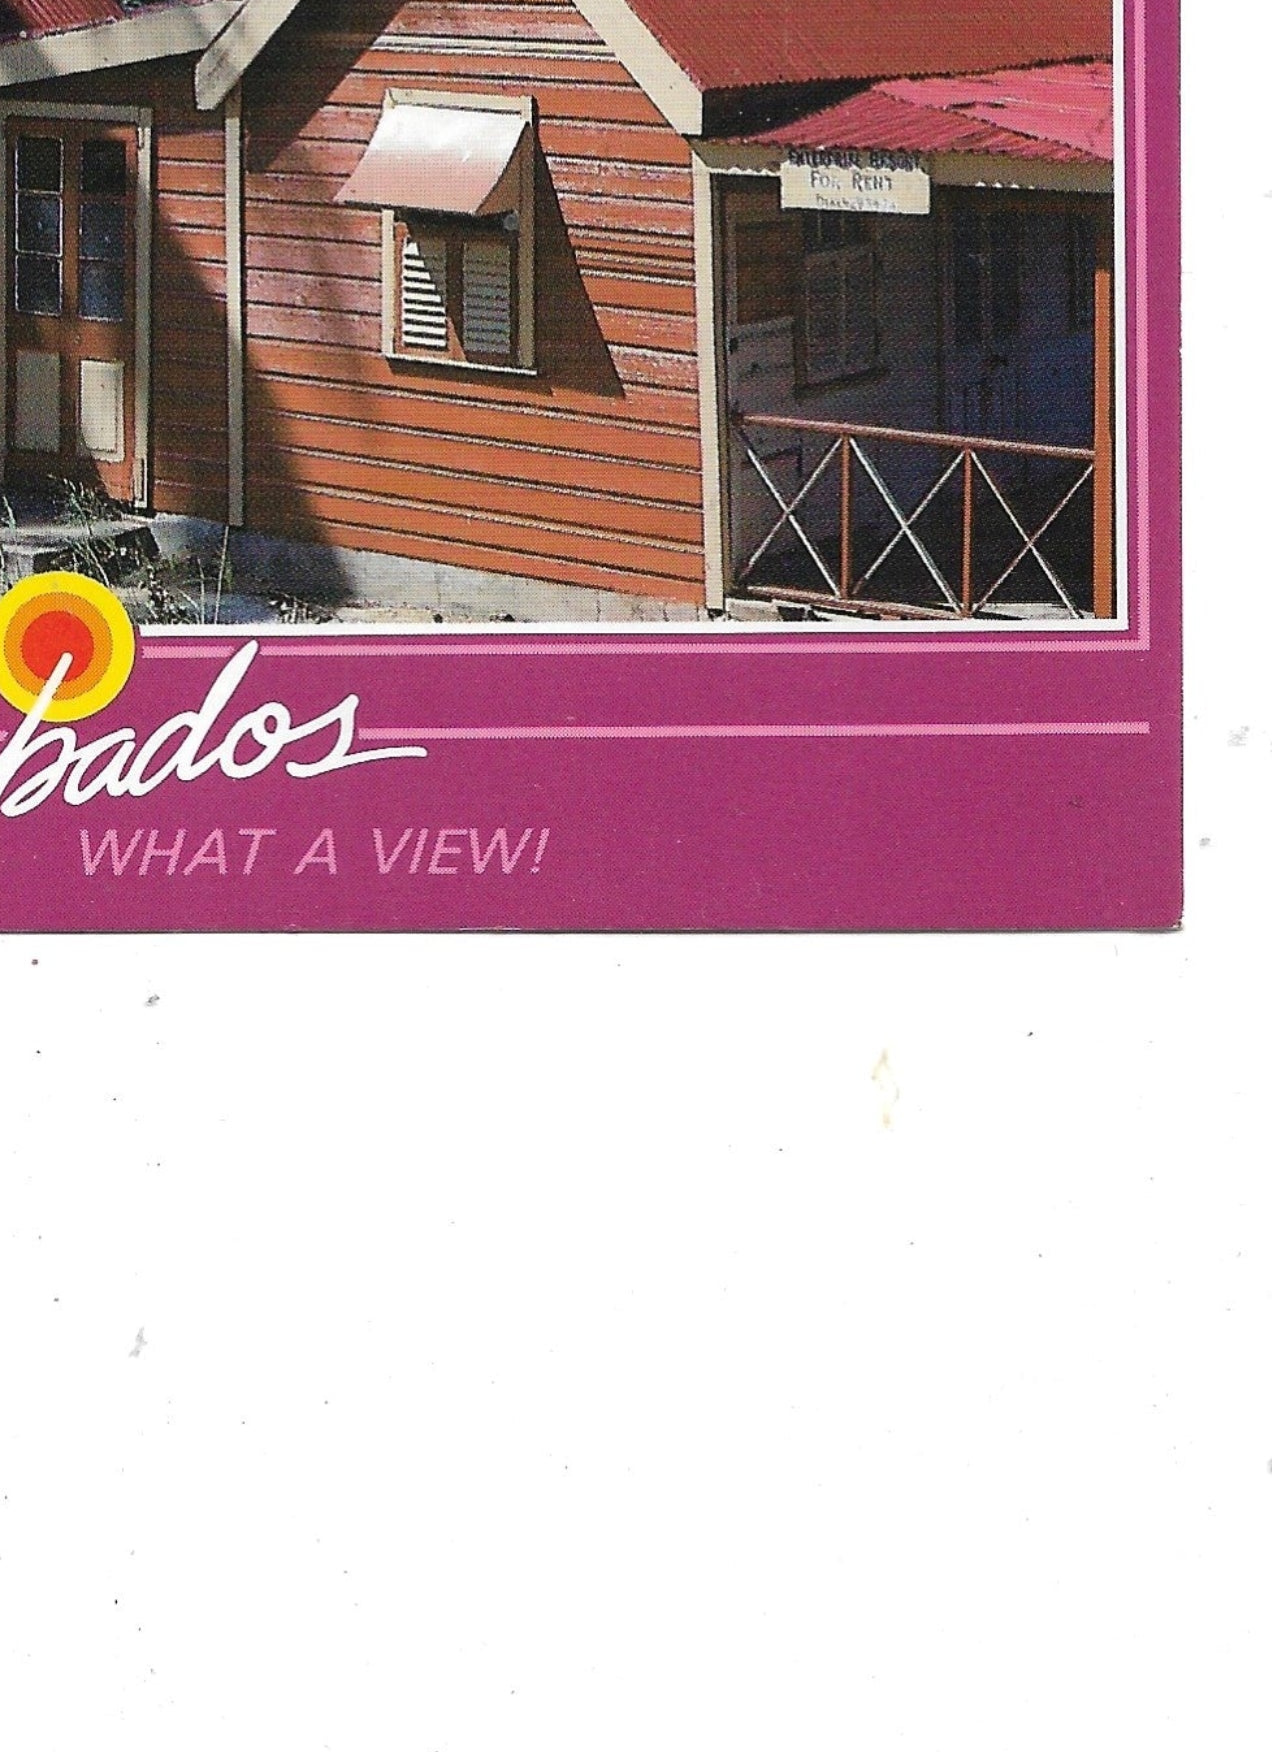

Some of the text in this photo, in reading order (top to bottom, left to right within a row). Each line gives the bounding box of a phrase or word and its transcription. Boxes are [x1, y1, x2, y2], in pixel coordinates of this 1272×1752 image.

[852, 172, 893, 192] RENT
[79, 827, 552, 877] WHAT A VIEW!
